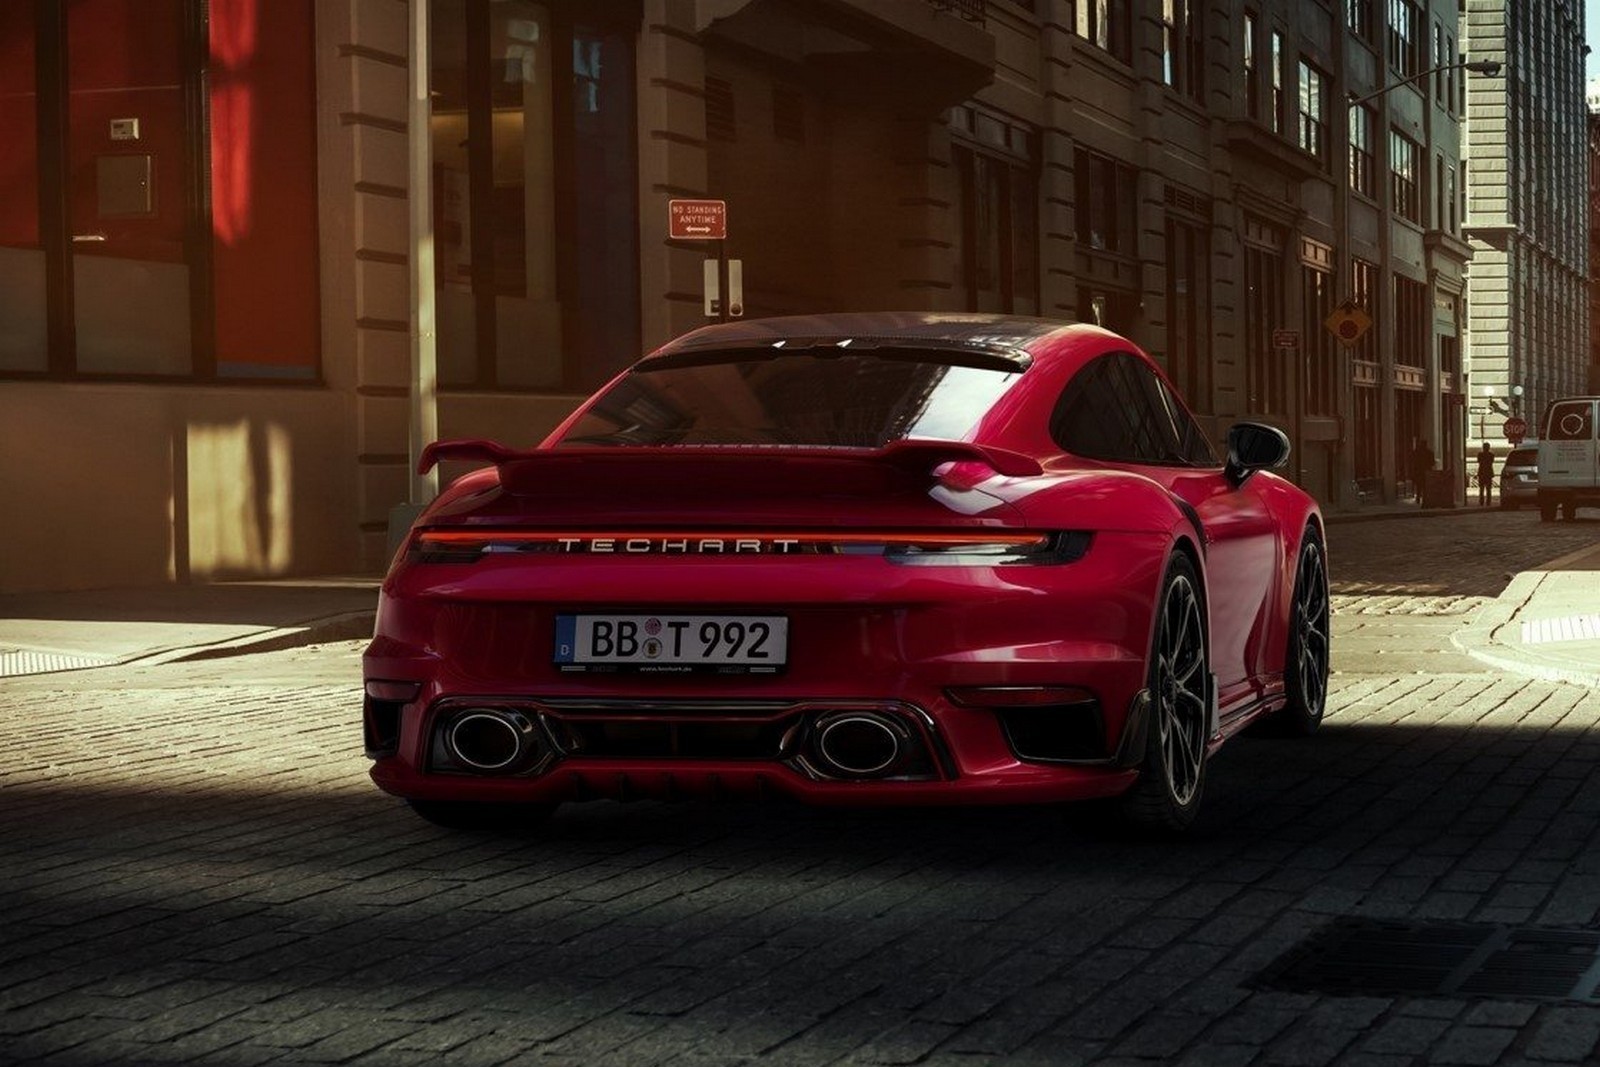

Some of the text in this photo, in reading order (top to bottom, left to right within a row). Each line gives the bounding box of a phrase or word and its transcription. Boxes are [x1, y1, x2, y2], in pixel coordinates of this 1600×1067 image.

[673, 206, 722, 214] NO STANDING
[680, 216, 716, 224] ANYTIME
[1505, 423, 1525, 434] STOP
[558, 538, 799, 552] TECHART
[591, 621, 771, 659] BB T 992
[561, 644, 570, 655] D
